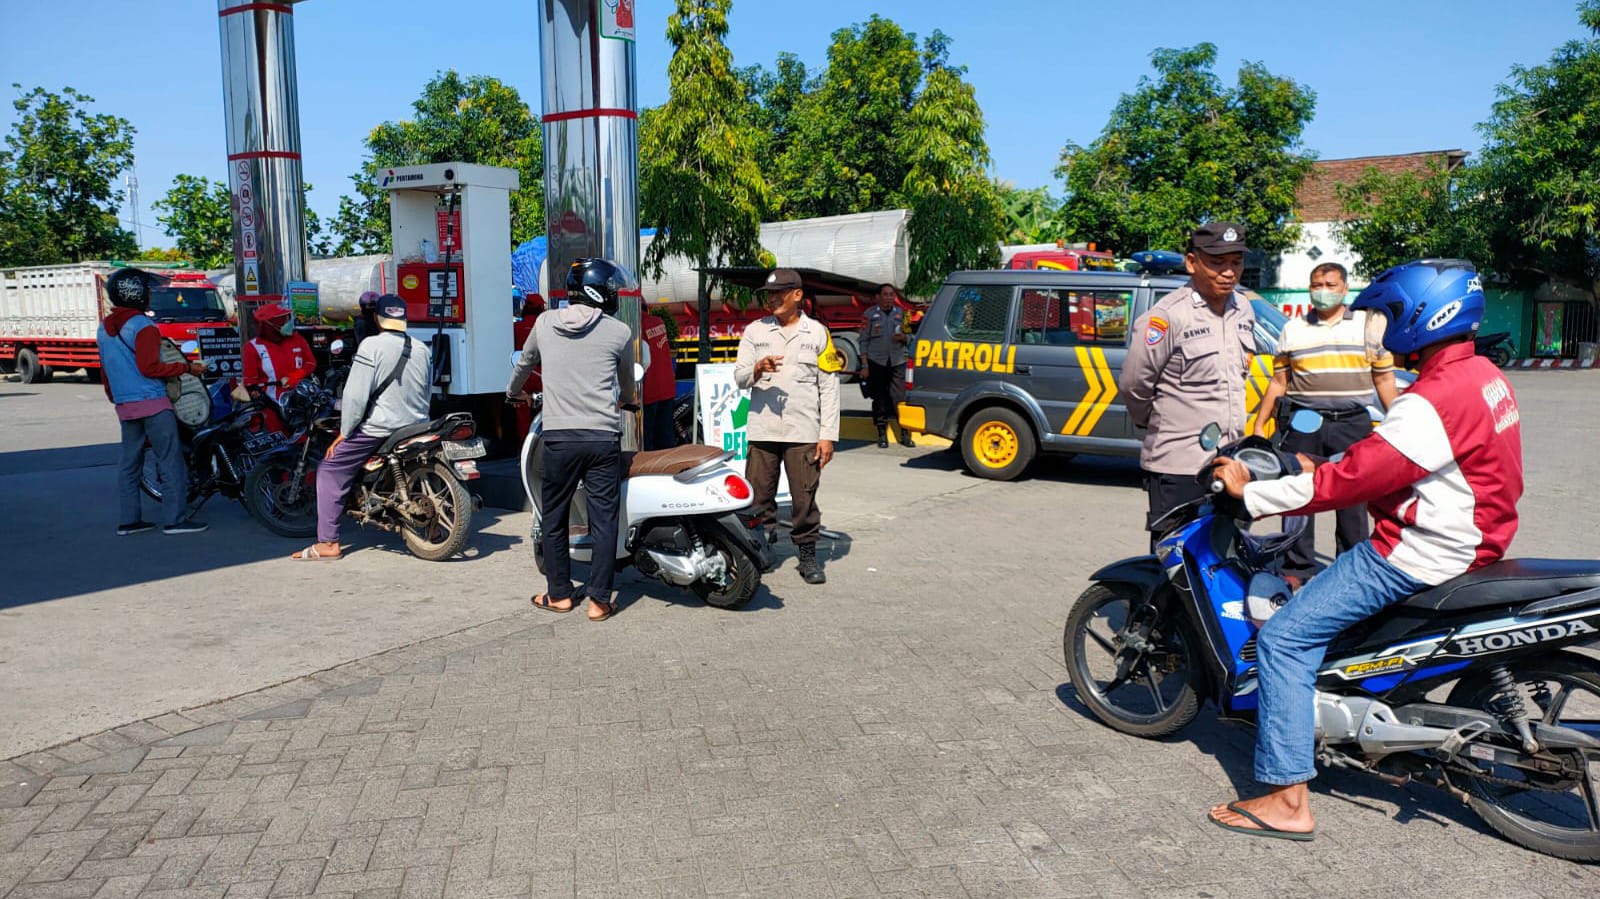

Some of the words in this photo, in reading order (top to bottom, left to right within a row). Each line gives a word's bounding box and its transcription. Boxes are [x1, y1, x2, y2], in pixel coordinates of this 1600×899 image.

[1431, 302, 1457, 327] INK
[1183, 326, 1211, 339] BENNY
[915, 339, 1017, 374] PATROLI
[1455, 619, 1599, 655] HONDA
[1345, 656, 1404, 674] PGM-FI
